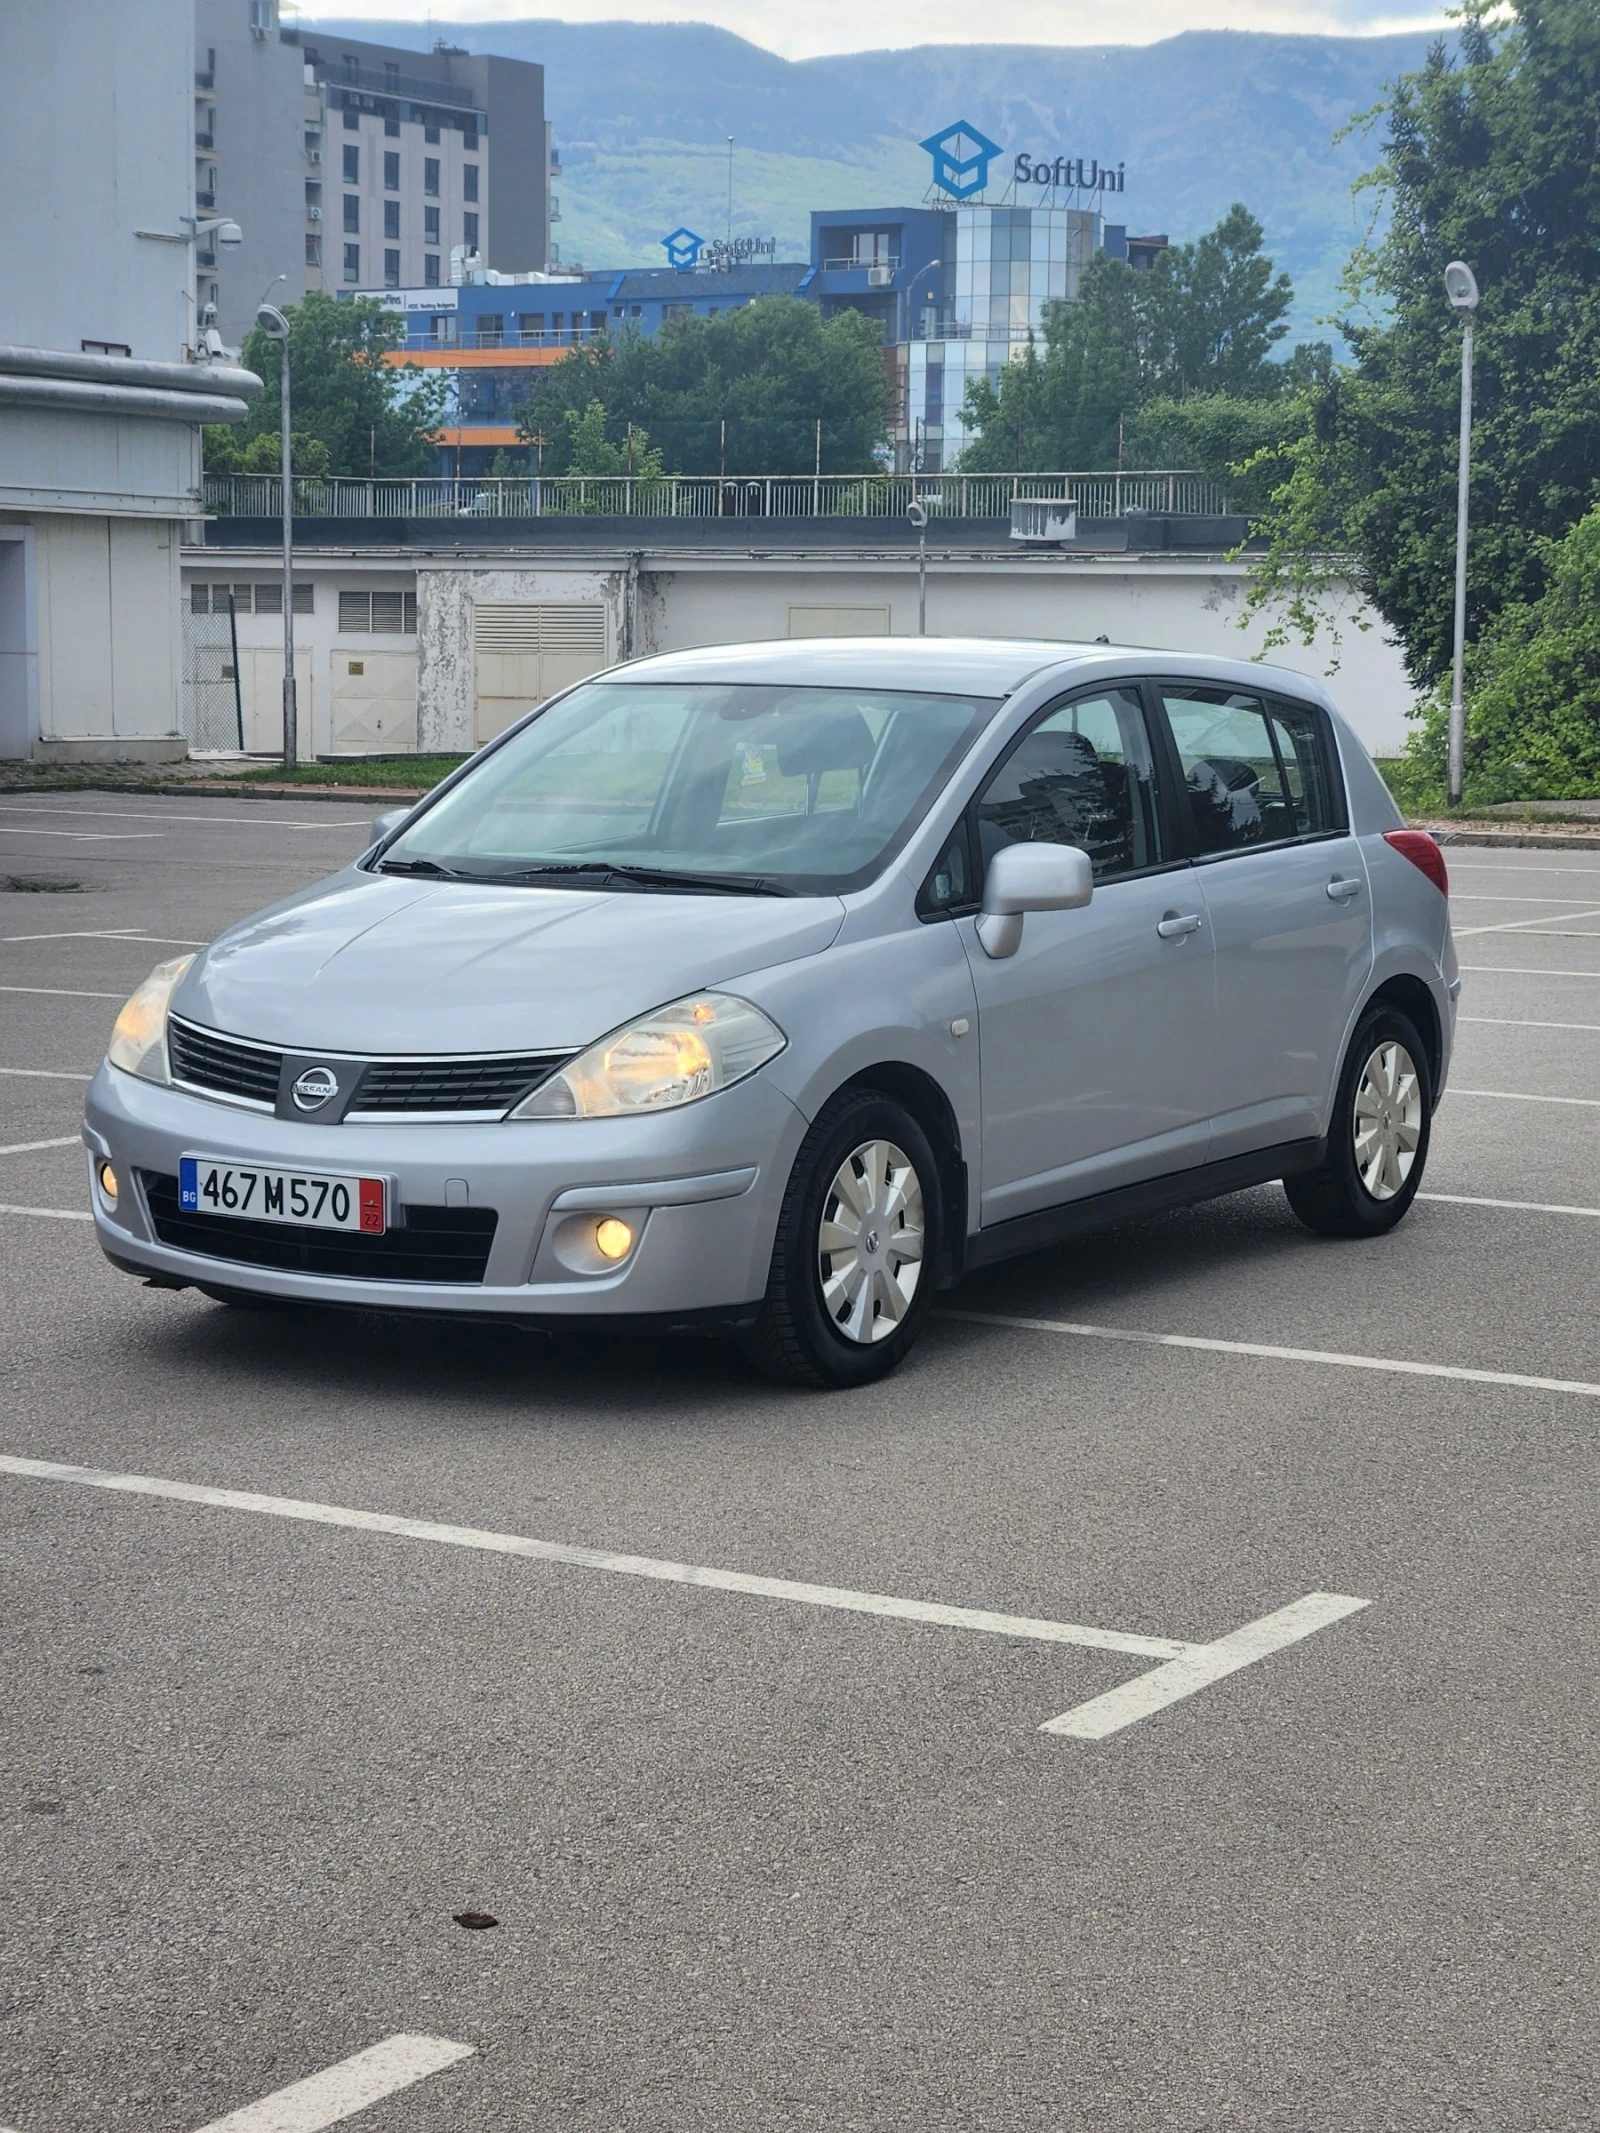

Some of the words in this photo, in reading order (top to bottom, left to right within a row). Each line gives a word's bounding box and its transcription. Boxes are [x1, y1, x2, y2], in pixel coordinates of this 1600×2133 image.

[1014, 153, 1125, 192] SoftUni
[712, 237, 776, 256] SoftUni
[293, 1084, 331, 1094] NISSAN
[182, 1191, 196, 1203] BG
[364, 1211, 380, 1226] 22
